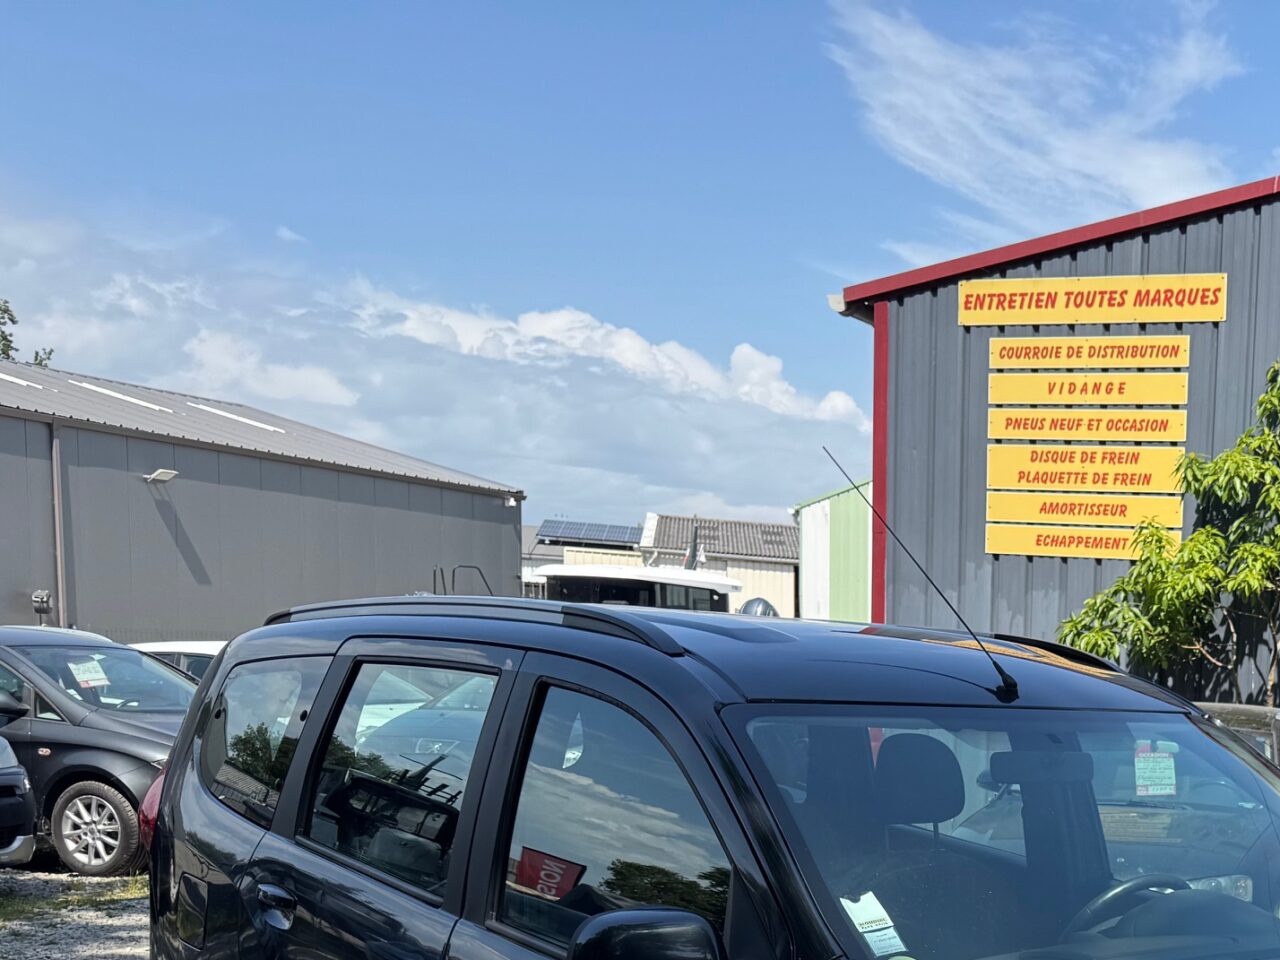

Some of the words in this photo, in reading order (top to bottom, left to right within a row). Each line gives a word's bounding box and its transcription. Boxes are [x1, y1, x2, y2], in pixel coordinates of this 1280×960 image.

[964, 292, 1058, 312] ENTRETIEN
[1064, 289, 1128, 309] TOUTES
[1133, 288, 1221, 307] MARQUES
[999, 346, 1062, 359] COURROIE
[1067, 346, 1083, 358] DE
[1088, 345, 1180, 359] DISTRIBUTION
[1048, 382, 1126, 395] VIDANGE
[1005, 418, 1045, 431] PNEUS
[1050, 418, 1083, 431] NEUF
[1087, 419, 1102, 431] ET
[1106, 419, 1168, 432] OCCASION
[1030, 450, 1076, 463] DISQUE
[1080, 451, 1097, 464] DE
[1101, 452, 1140, 464] FREIN
[1018, 471, 1088, 485] PLAQUETTE
[1092, 473, 1108, 485] DE
[1113, 473, 1152, 486] FREIN
[1039, 502, 1127, 517] AMORTISSEUR
[1036, 534, 1129, 550] ECHAPPEMENT
